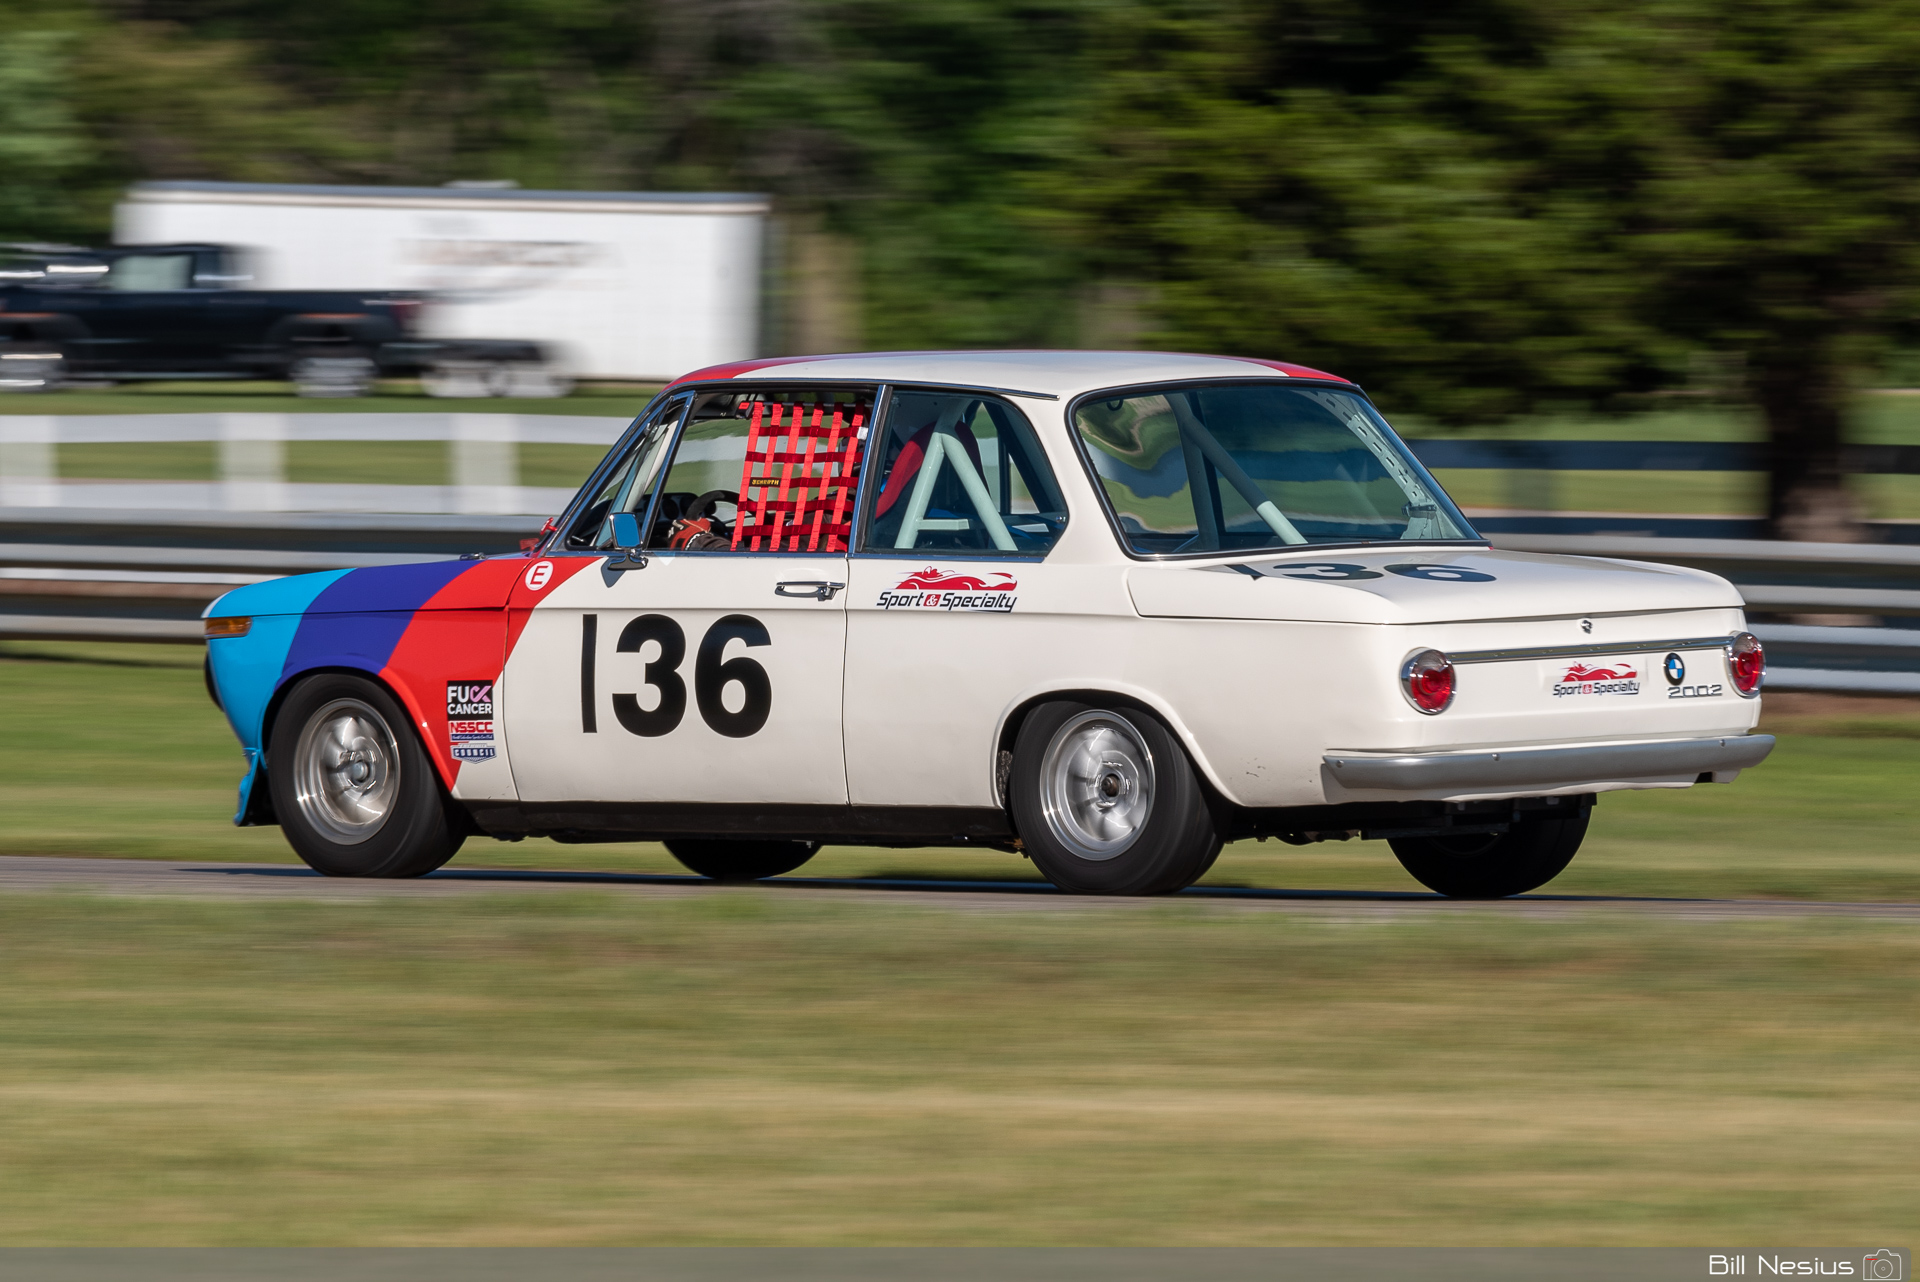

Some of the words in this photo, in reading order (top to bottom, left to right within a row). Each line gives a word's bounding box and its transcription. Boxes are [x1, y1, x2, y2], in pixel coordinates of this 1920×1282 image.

[530, 565, 549, 585] E
[1224, 563, 1496, 582] 136
[876, 591, 924, 610] Sport
[939, 592, 1017, 613] Specialty
[578, 613, 772, 739] 136
[447, 685, 492, 703] FUCK
[1553, 683, 1582, 698] Sport
[1593, 680, 1640, 695] Specialty
[1667, 684, 1723, 699] 2002
[447, 703, 493, 715] CANCER
[450, 721, 494, 733] NSSCC
[454, 748, 494, 757] COUNCIL
